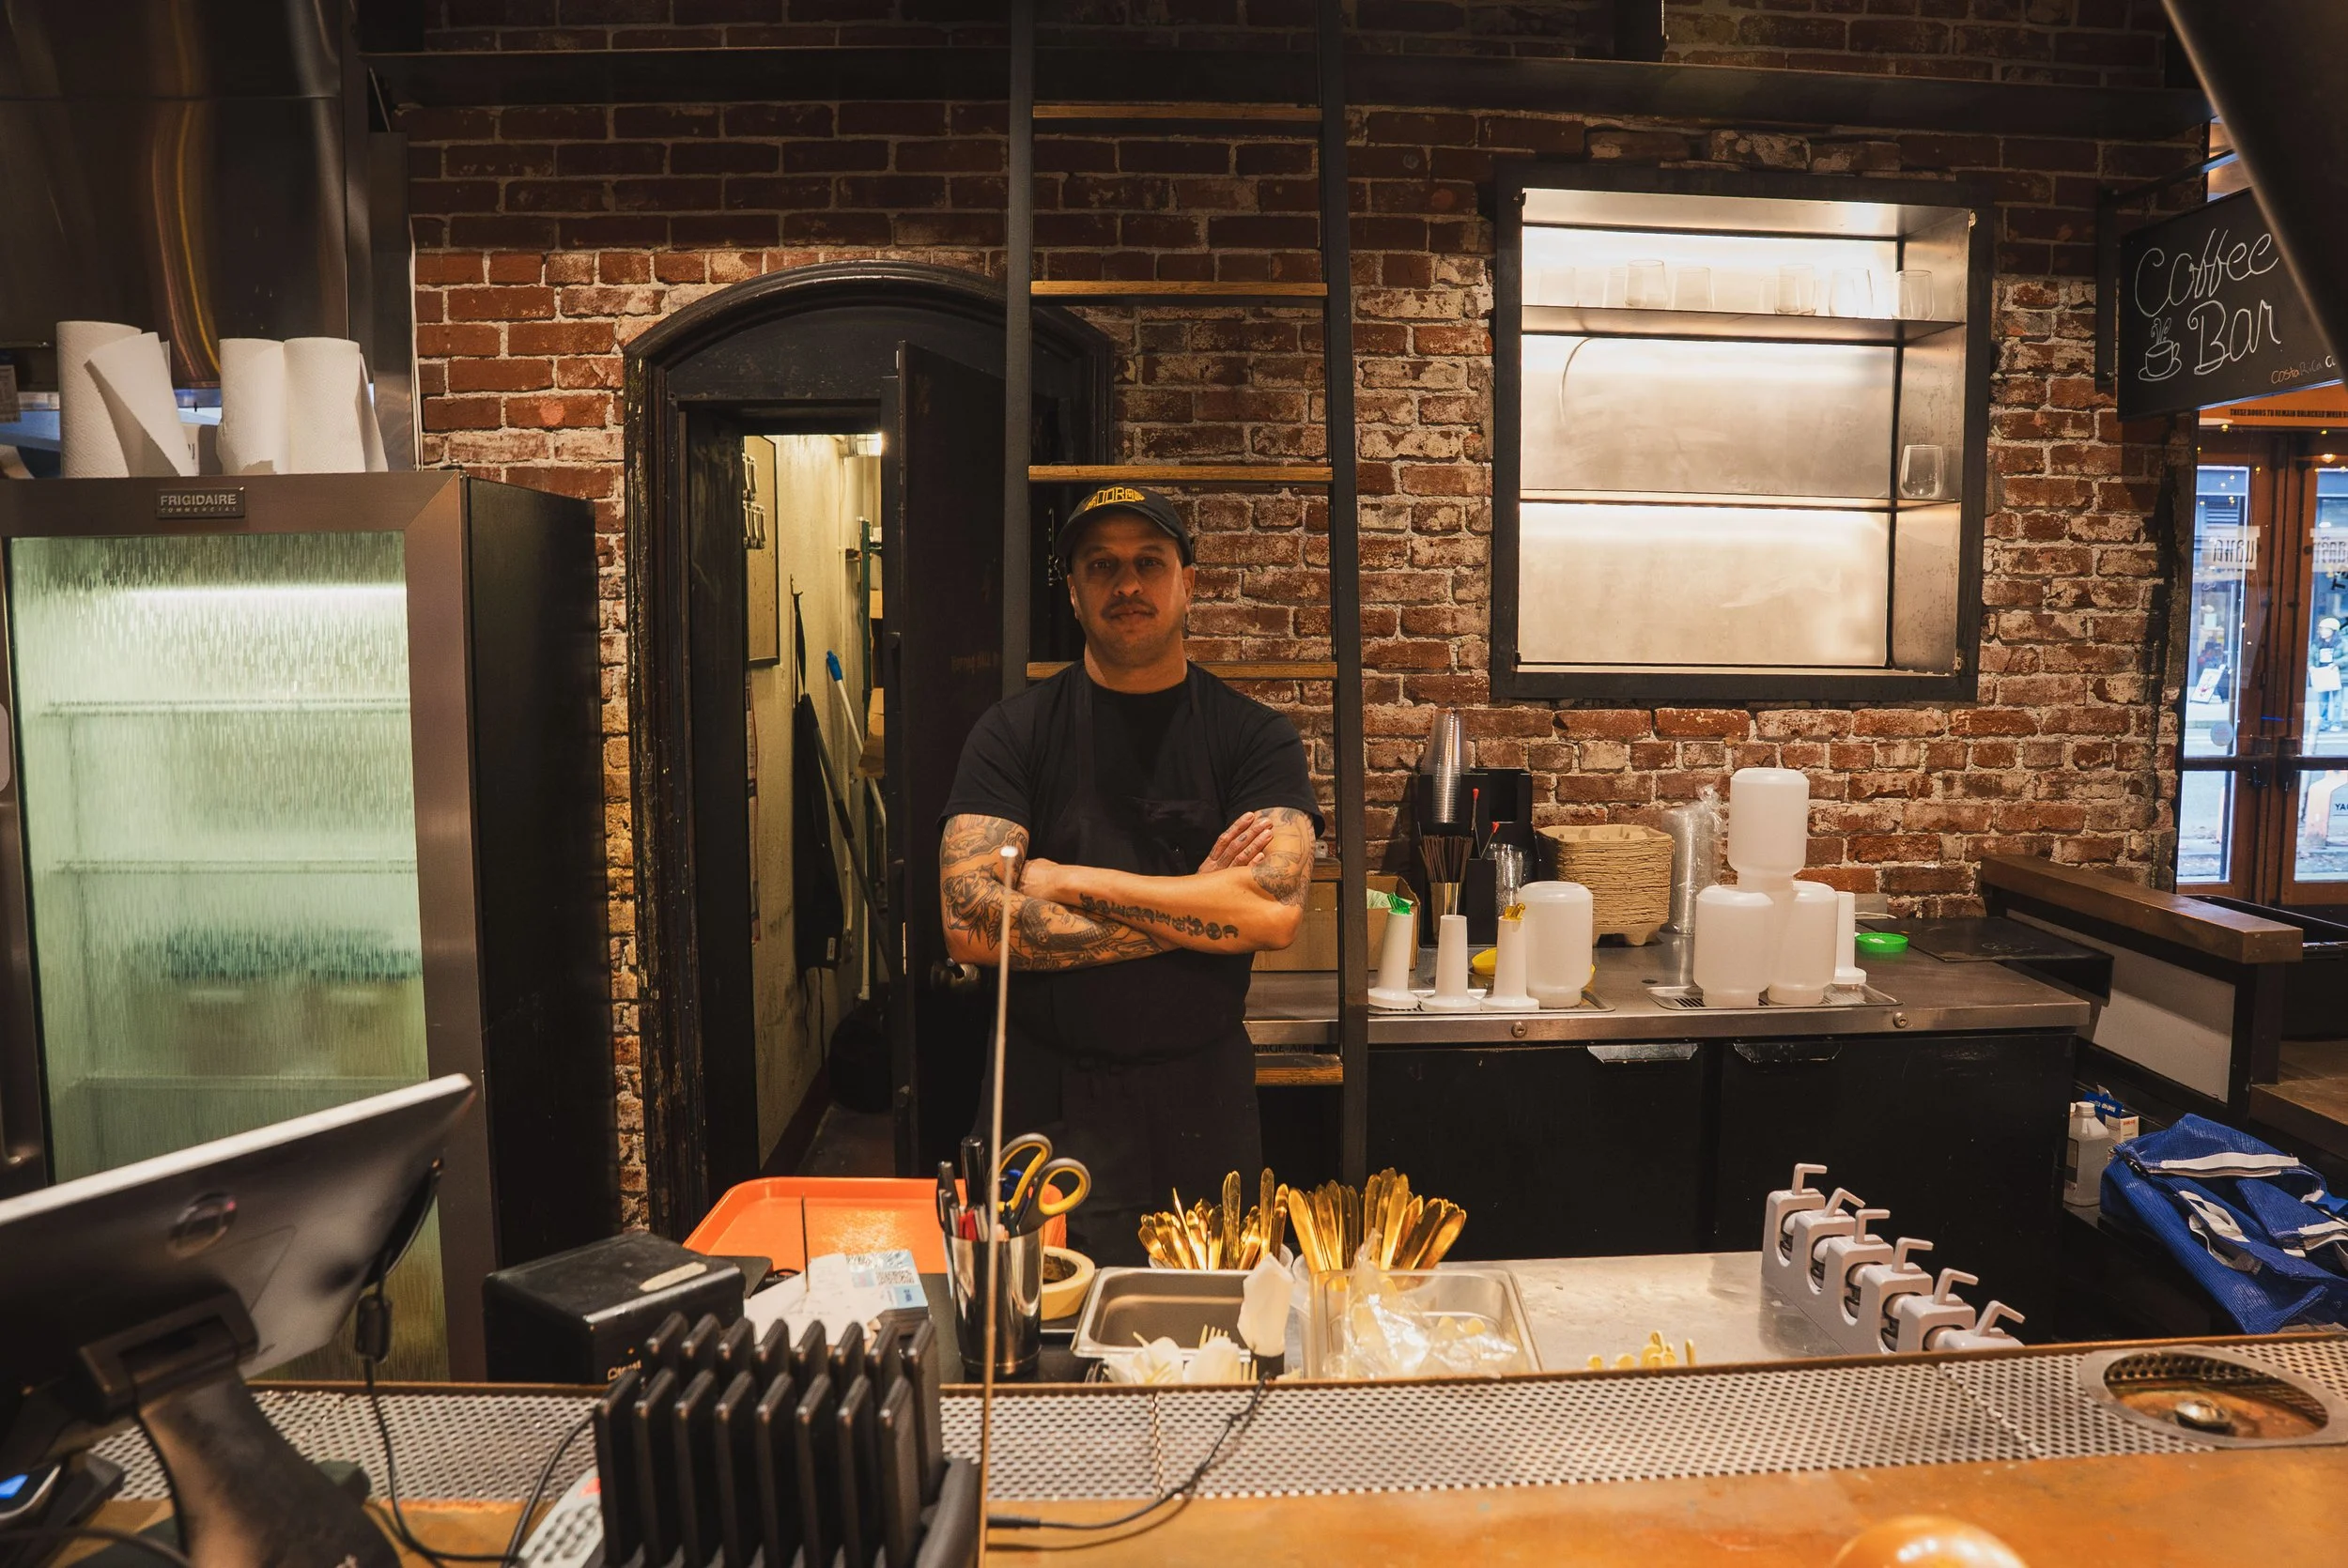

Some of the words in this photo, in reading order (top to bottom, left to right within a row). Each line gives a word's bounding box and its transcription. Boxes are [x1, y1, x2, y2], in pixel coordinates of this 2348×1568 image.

[2135, 228, 2279, 317] Coffee
[2187, 300, 2281, 376] Bar
[161, 494, 237, 506] FRIGIDAIRE
